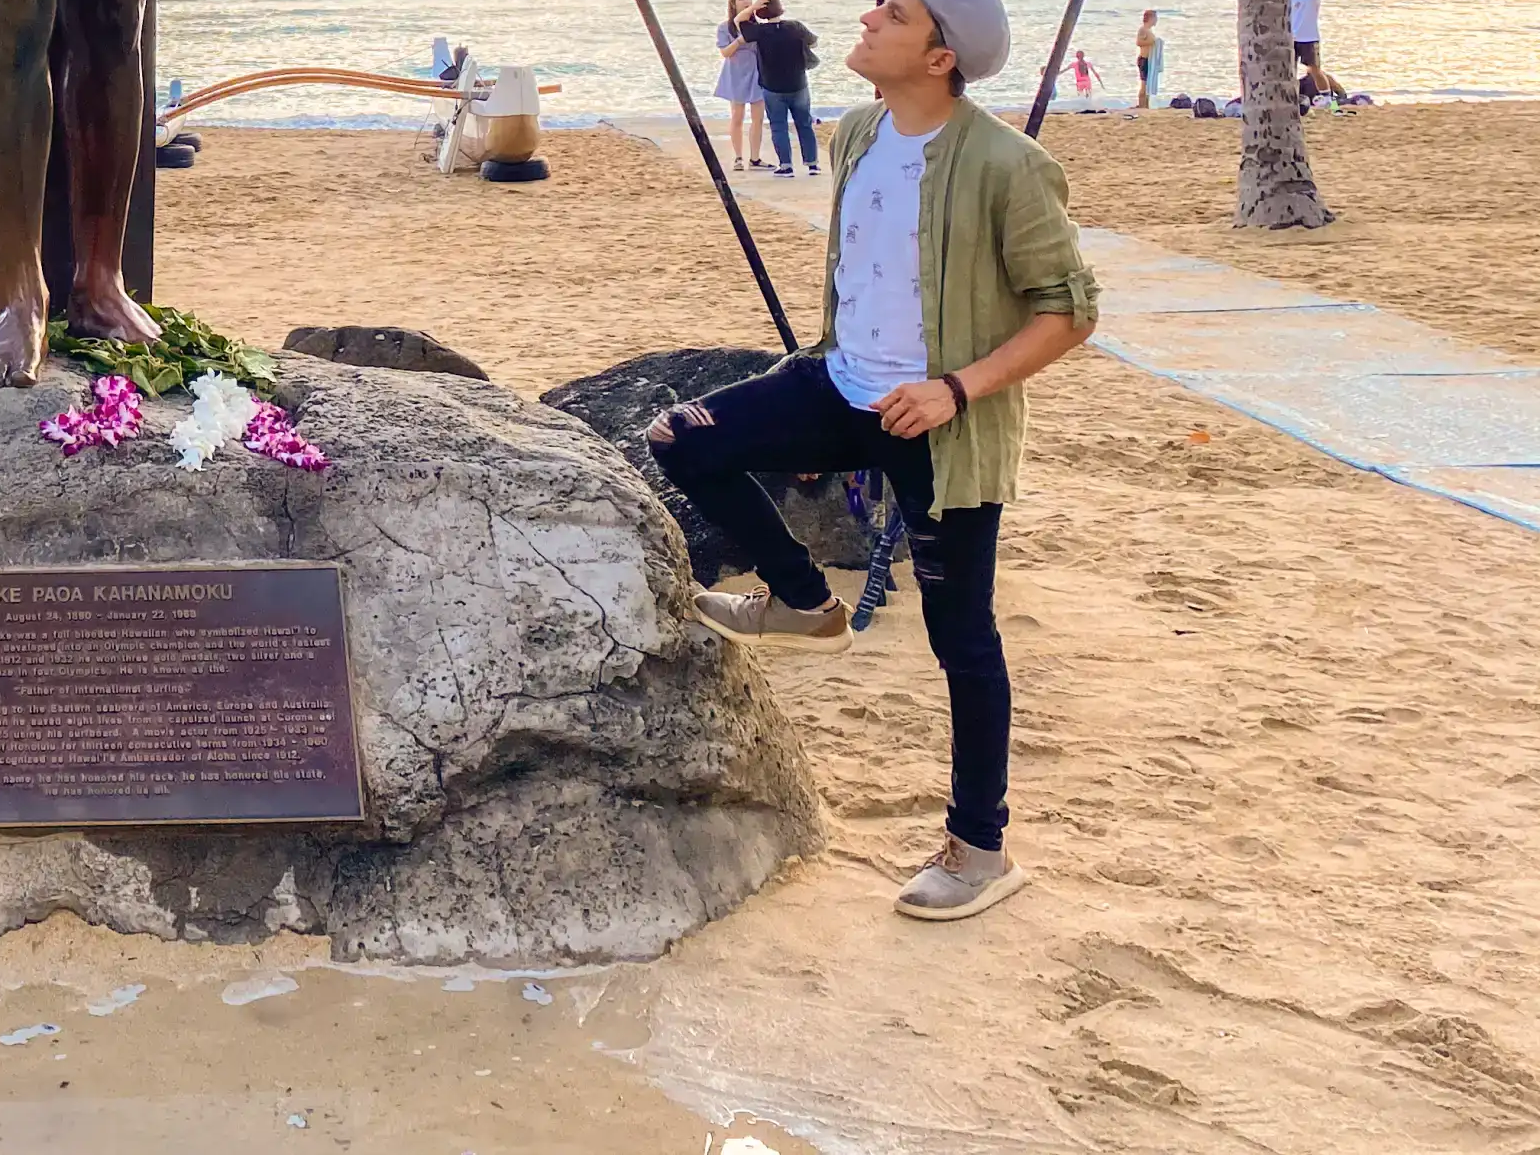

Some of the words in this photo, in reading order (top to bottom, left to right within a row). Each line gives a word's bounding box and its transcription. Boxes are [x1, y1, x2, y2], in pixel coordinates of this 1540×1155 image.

[32, 587, 84, 603] PAOA
[94, 585, 233, 602] KAHANAMOKU
[4, 612, 41, 623] August
[107, 610, 147, 621] January
[41, 632, 48, 640] a
[52, 630, 69, 639] full
[74, 629, 116, 639] blooded
[175, 628, 195, 637] who
[200, 627, 259, 639] symbolized
[304, 625, 316, 635] to
[3, 642, 56, 654] developed
[60, 642, 81, 651] into
[103, 641, 145, 652] Olympic
[150, 640, 200, 652] champion
[204, 639, 224, 649] and
[229, 639, 245, 648] the
[292, 637, 330, 647] fastest
[0, 655, 22, 665] 1912
[26, 655, 45, 664] and
[50, 654, 73, 664] 1932
[78, 654, 90, 663] he
[121, 653, 148, 663] three
[154, 653, 177, 664] gold
[226, 652, 245, 661] two
[251, 651, 279, 661] silver
[283, 651, 303, 660] and
[33, 667, 53, 676] four
[119, 666, 133, 675] He
[138, 665, 148, 675] is
[153, 665, 187, 674] known
[60, 685, 70, 695] of
[74, 684, 141, 694] International
[12, 705, 24, 714] to
[29, 705, 45, 714] the
[50, 704, 91, 714] Eastern
[96, 703, 145, 713] seaboard
[150, 702, 161, 712] of
[217, 701, 253, 712] Europe
[259, 700, 278, 710] and
[13, 717, 25, 726] he
[31, 716, 61, 726] saved
[67, 716, 93, 727] eight
[98, 715, 122, 725] lives
[128, 715, 152, 724] from
[168, 714, 216, 725] capsized
[221, 713, 255, 723] launch
[261, 713, 272, 722] at
[276, 712, 313, 722] Corona
[319, 711, 336, 721] del
[13, 729, 42, 740] using
[47, 728, 63, 738] his
[132, 727, 140, 736] A
[144, 726, 175, 736] movie
[180, 726, 208, 735] actor
[213, 725, 238, 735] from
[312, 723, 325, 733] he
[10, 741, 56, 751] Honolulu
[61, 741, 77, 750] for
[81, 740, 123, 750] thirteen
[128, 738, 192, 749] consecutive
[196, 738, 227, 747] terms
[232, 737, 257, 747] from
[51, 756, 64, 764] as
[120, 752, 186, 762] Ambassador
[191, 752, 202, 761] of
[207, 751, 237, 761] Aloha
[242, 751, 270, 761] since
[38, 774, 52, 784] he
[57, 774, 76, 783] has
[81, 773, 124, 783] honored
[129, 773, 146, 782] his
[182, 772, 195, 781] he
[200, 771, 220, 781] has
[224, 770, 268, 780] honored
[273, 770, 289, 780] his
[45, 786, 58, 795] he
[63, 786, 82, 795] has
[87, 785, 131, 795] honored
